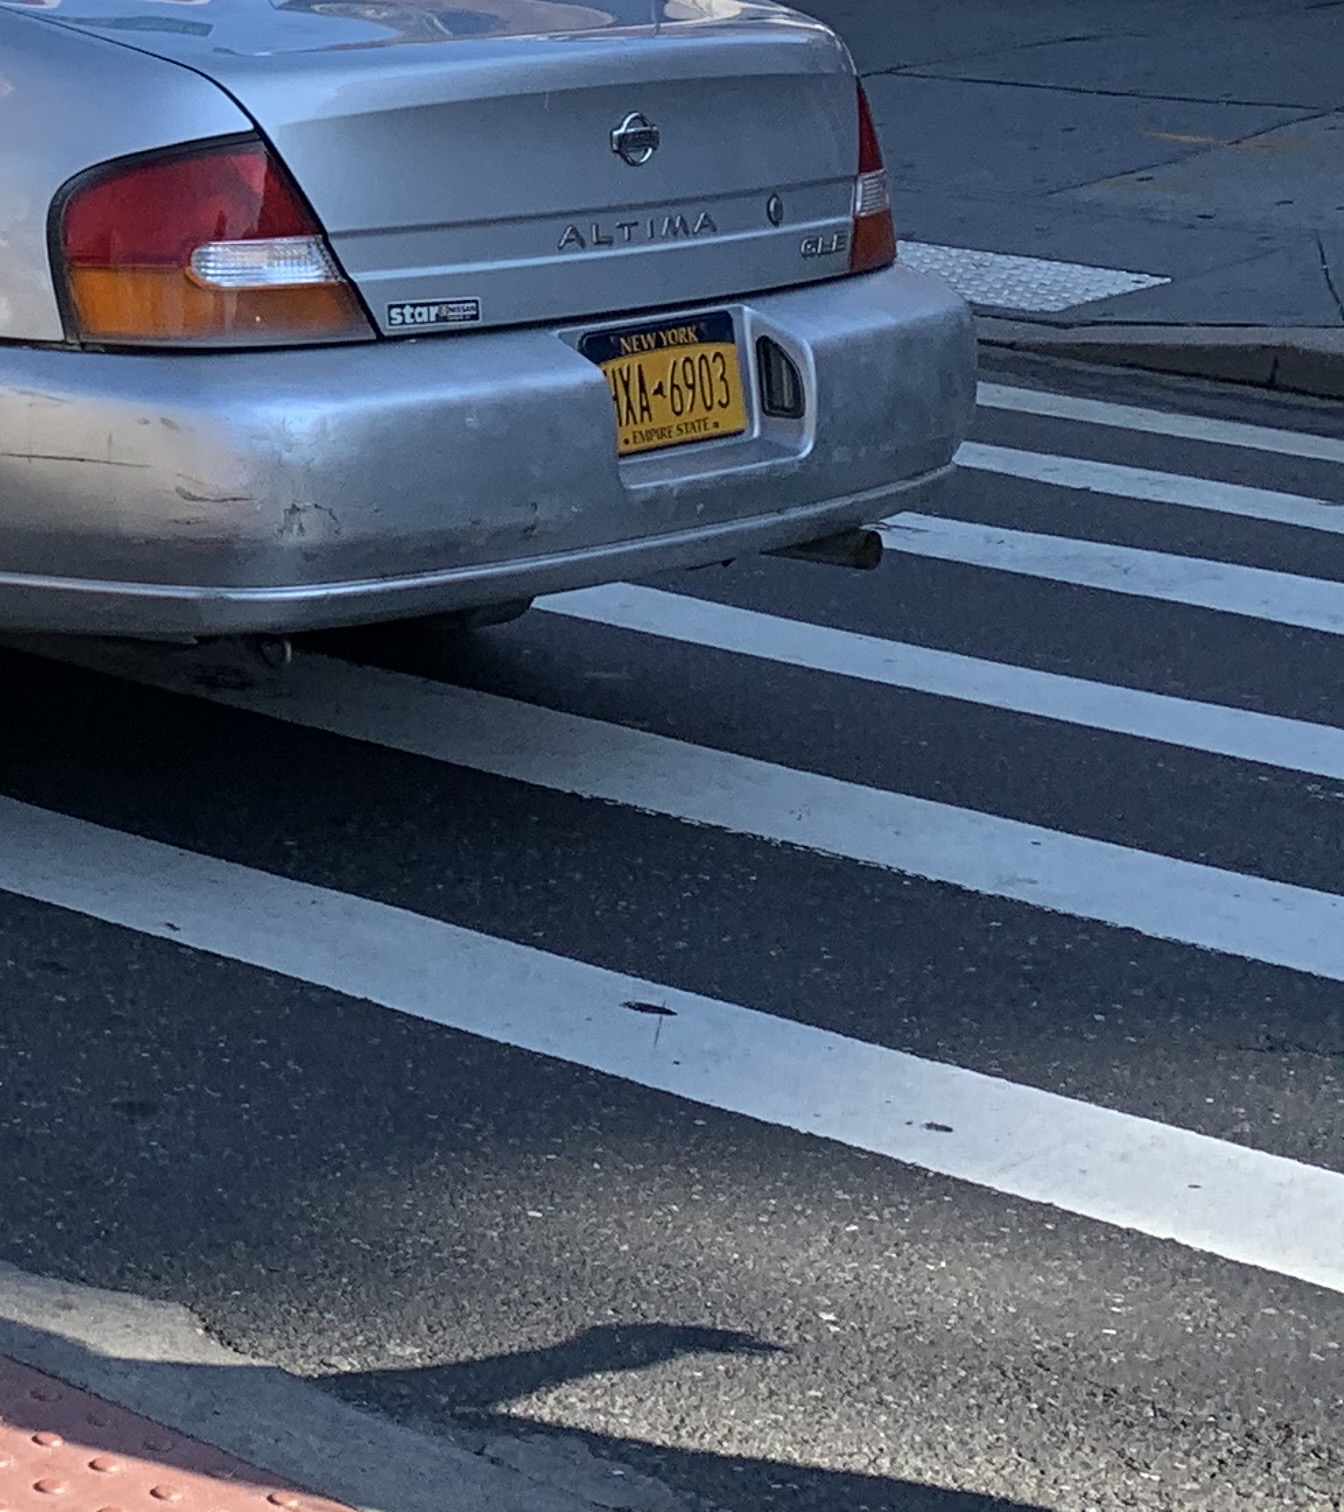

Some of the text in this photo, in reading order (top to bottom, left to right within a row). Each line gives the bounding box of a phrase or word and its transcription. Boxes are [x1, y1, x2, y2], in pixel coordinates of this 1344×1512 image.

[557, 211, 718, 250] ALTIMA
[800, 232, 848, 258] GLE
[390, 304, 439, 325] star
[619, 324, 700, 355] NEW YORK
[631, 417, 710, 445] EMPIRE STATE
